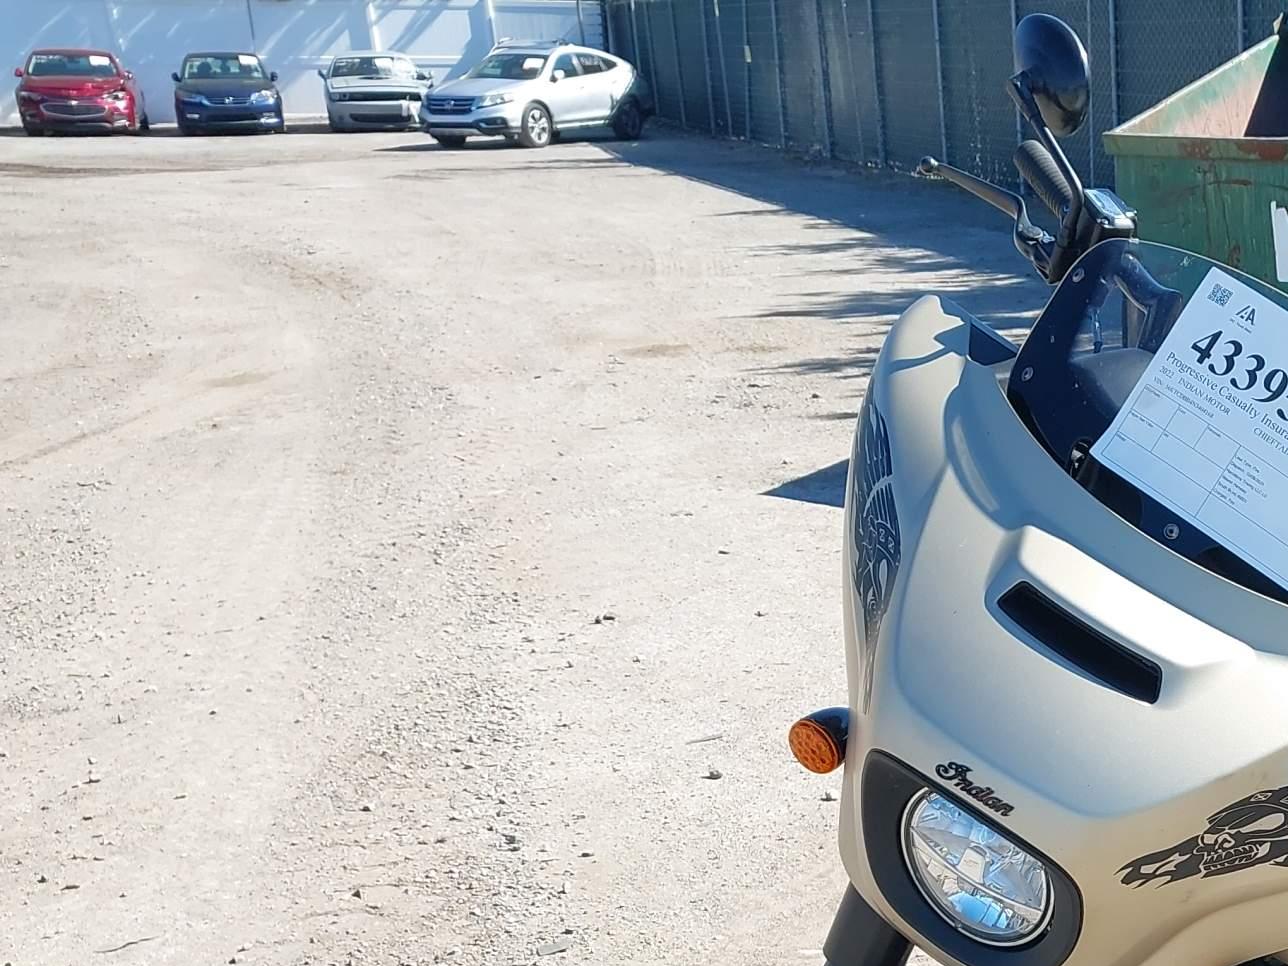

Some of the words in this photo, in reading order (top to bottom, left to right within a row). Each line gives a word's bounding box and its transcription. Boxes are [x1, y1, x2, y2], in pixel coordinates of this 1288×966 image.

[1167, 351, 1219, 391] Progressive
[1219, 385, 1261, 420] Casualty
[1178, 377, 1203, 399] INDIAN
[1203, 393, 1231, 415] MOTOR
[935, 762, 1016, 817] Indian
